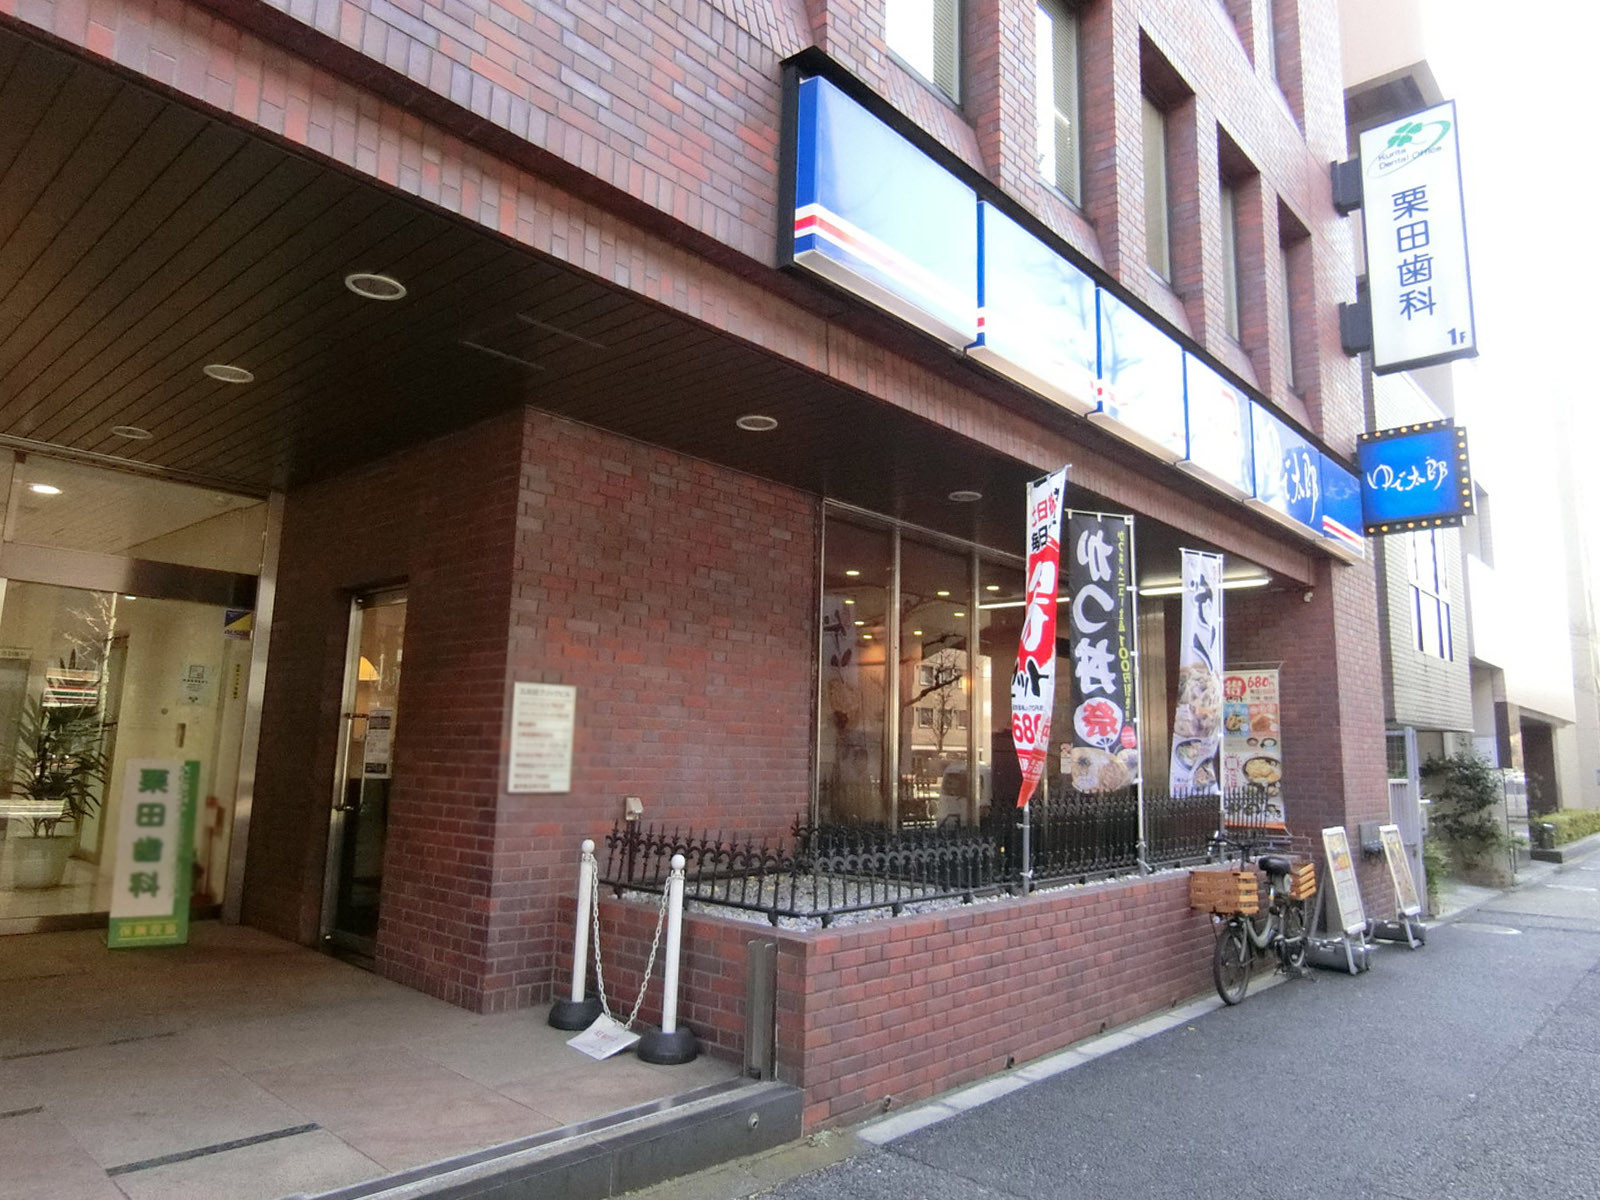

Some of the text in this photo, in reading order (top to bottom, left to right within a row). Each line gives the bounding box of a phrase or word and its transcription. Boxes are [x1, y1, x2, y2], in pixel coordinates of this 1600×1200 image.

[1378, 154, 1409, 170] Dental
[1391, 184, 1436, 321] 栗田歯科
[1447, 327, 1467, 346] 1F
[1366, 456, 1448, 492] ゆで太郎
